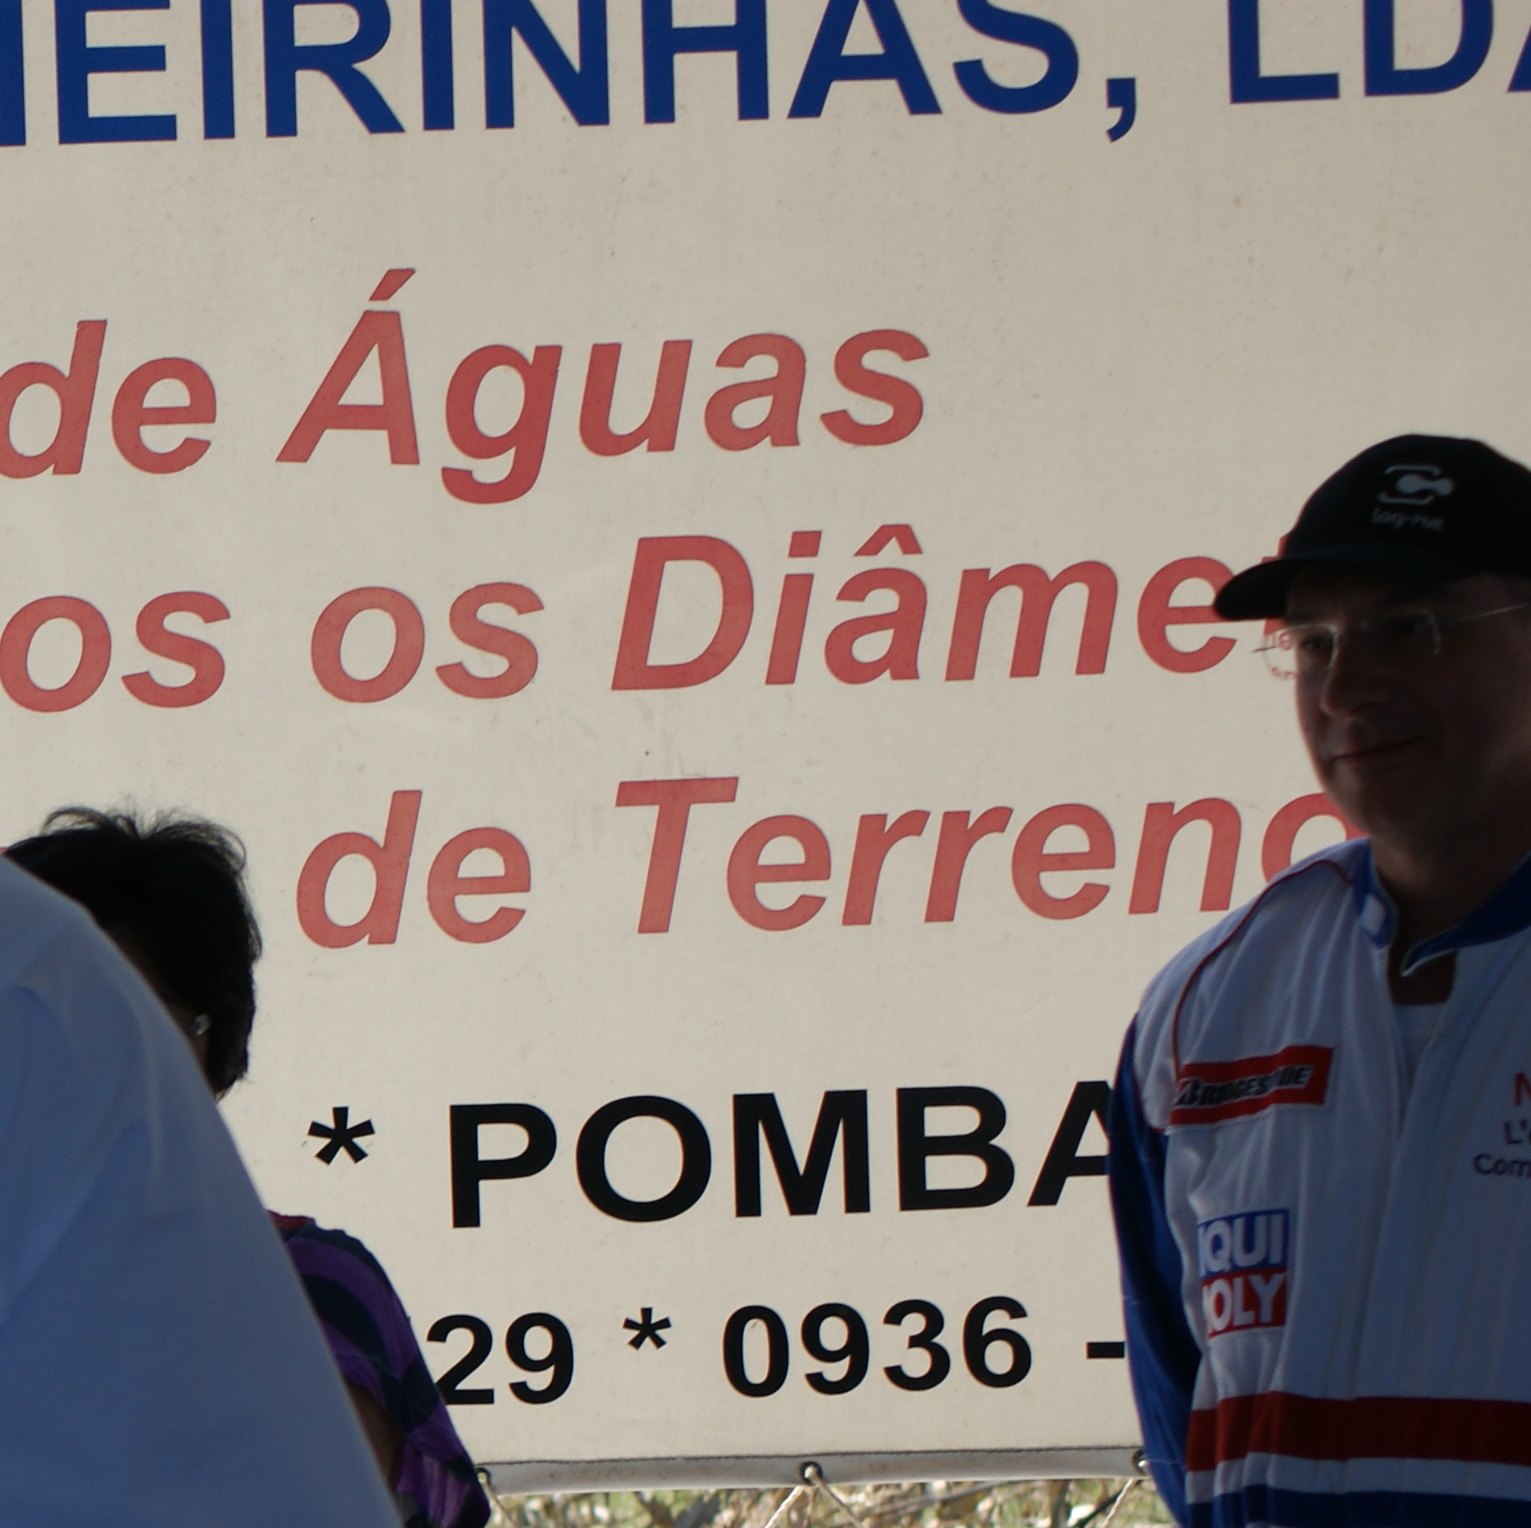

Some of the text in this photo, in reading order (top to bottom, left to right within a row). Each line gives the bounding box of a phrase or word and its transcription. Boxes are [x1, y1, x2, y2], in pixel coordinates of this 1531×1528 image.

[1227, 0, 1531, 105] LD
[275, 268, 930, 504] Águas
[311, 582, 544, 704] os
[611, 524, 1289, 691] Diâme
[297, 789, 532, 949] de
[722, 1295, 1033, 1398] 0936
[1203, 1273, 1286, 1332] OLY
